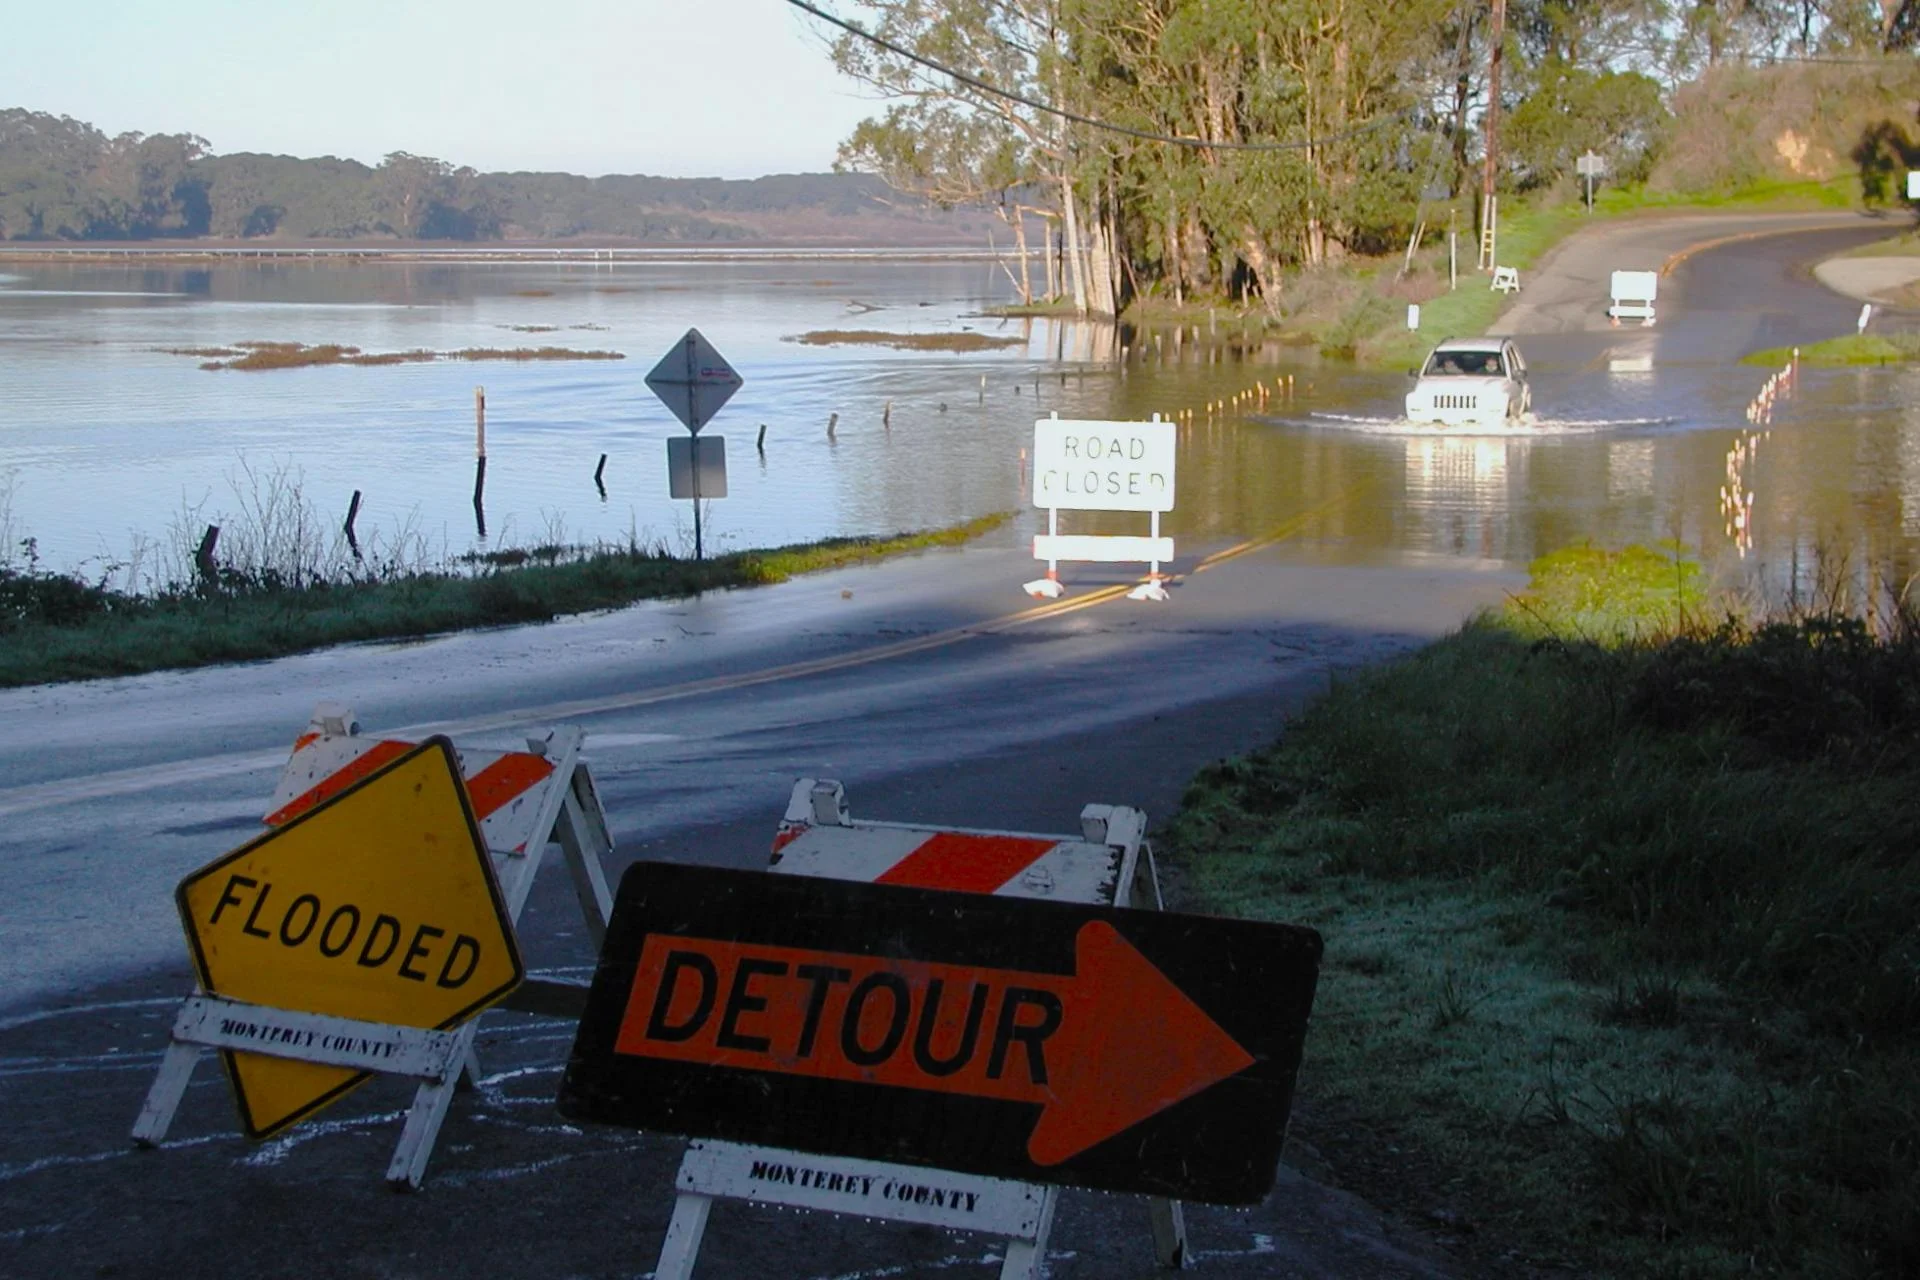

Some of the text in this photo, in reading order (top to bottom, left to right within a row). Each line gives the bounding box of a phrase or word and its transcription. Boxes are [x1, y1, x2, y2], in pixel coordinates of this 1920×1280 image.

[1064, 435, 1145, 460] ROAD
[1043, 469, 1165, 495] CLOSED
[209, 874, 481, 989] FLOODED
[219, 1018, 397, 1058] MONTEREY COUNTY
[645, 950, 1064, 1086] DETOUR
[748, 1161, 980, 1213] MONTEREY COUNTY
